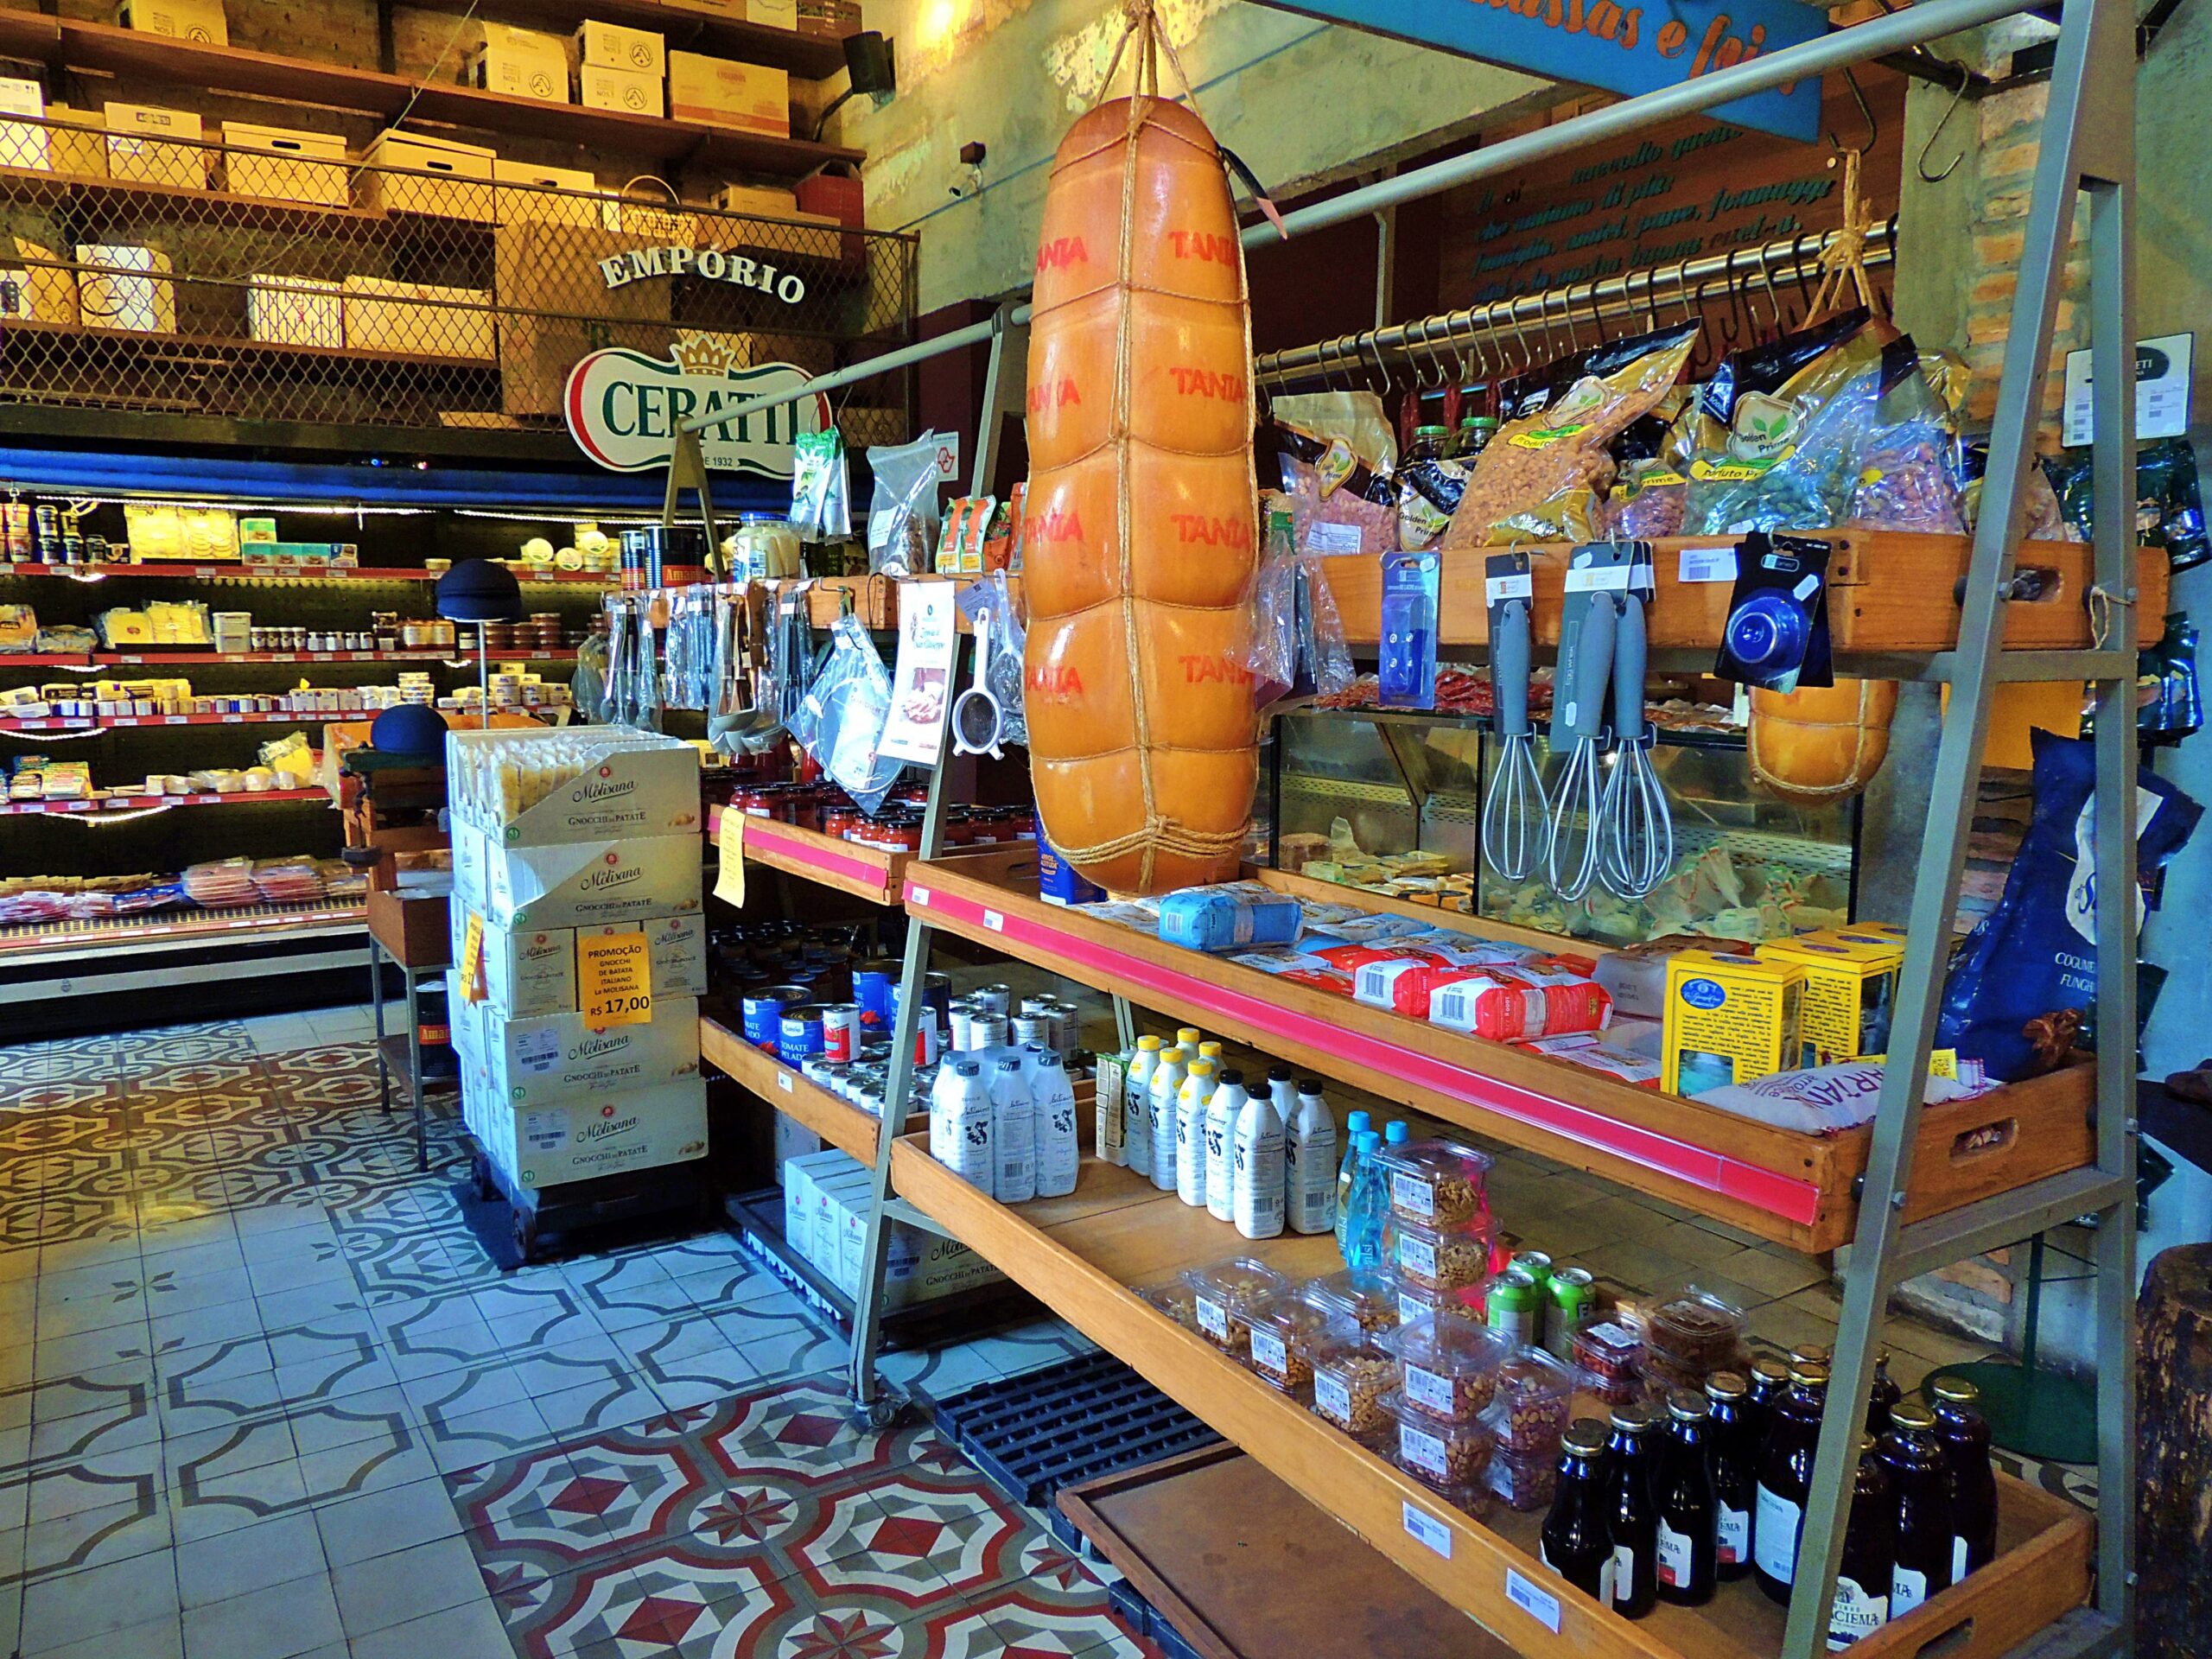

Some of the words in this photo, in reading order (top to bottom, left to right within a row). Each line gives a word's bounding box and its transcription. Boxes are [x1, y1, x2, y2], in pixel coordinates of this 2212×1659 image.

[1467, 0, 1643, 50] assas
[1169, 367, 1247, 406] TANIA
[601, 381, 799, 445] CERATTI
[1758, 437, 1789, 453] Prime
[713, 456, 733, 467] 1932
[1399, 512, 1427, 524] Golden
[568, 816, 608, 826] GNOCCHI
[615, 811, 646, 822] PATATE
[622, 898, 652, 907] PATATE
[588, 945, 642, 959] PROMOÇÃO
[600, 958, 632, 968] GNOCCHI
[2055, 951, 2095, 974] COGUME
[609, 967, 633, 976] BATATA
[601, 976, 632, 985] ITALIANO
[603, 984, 639, 995] MOLISANA
[590, 1006, 603, 1017] R$
[605, 995, 650, 1014] 17,00
[780, 1041, 810, 1052] TOMATE
[781, 1052, 804, 1061] PELAD
[563, 1071, 603, 1083] GNOCCHI
[610, 1065, 640, 1077] PATATE
[572, 1154, 612, 1166] GNOCCHI
[618, 1145, 648, 1157] PATATE
[925, 1271, 963, 1286] GNOCCHI
[971, 1265, 998, 1276] PATAT
